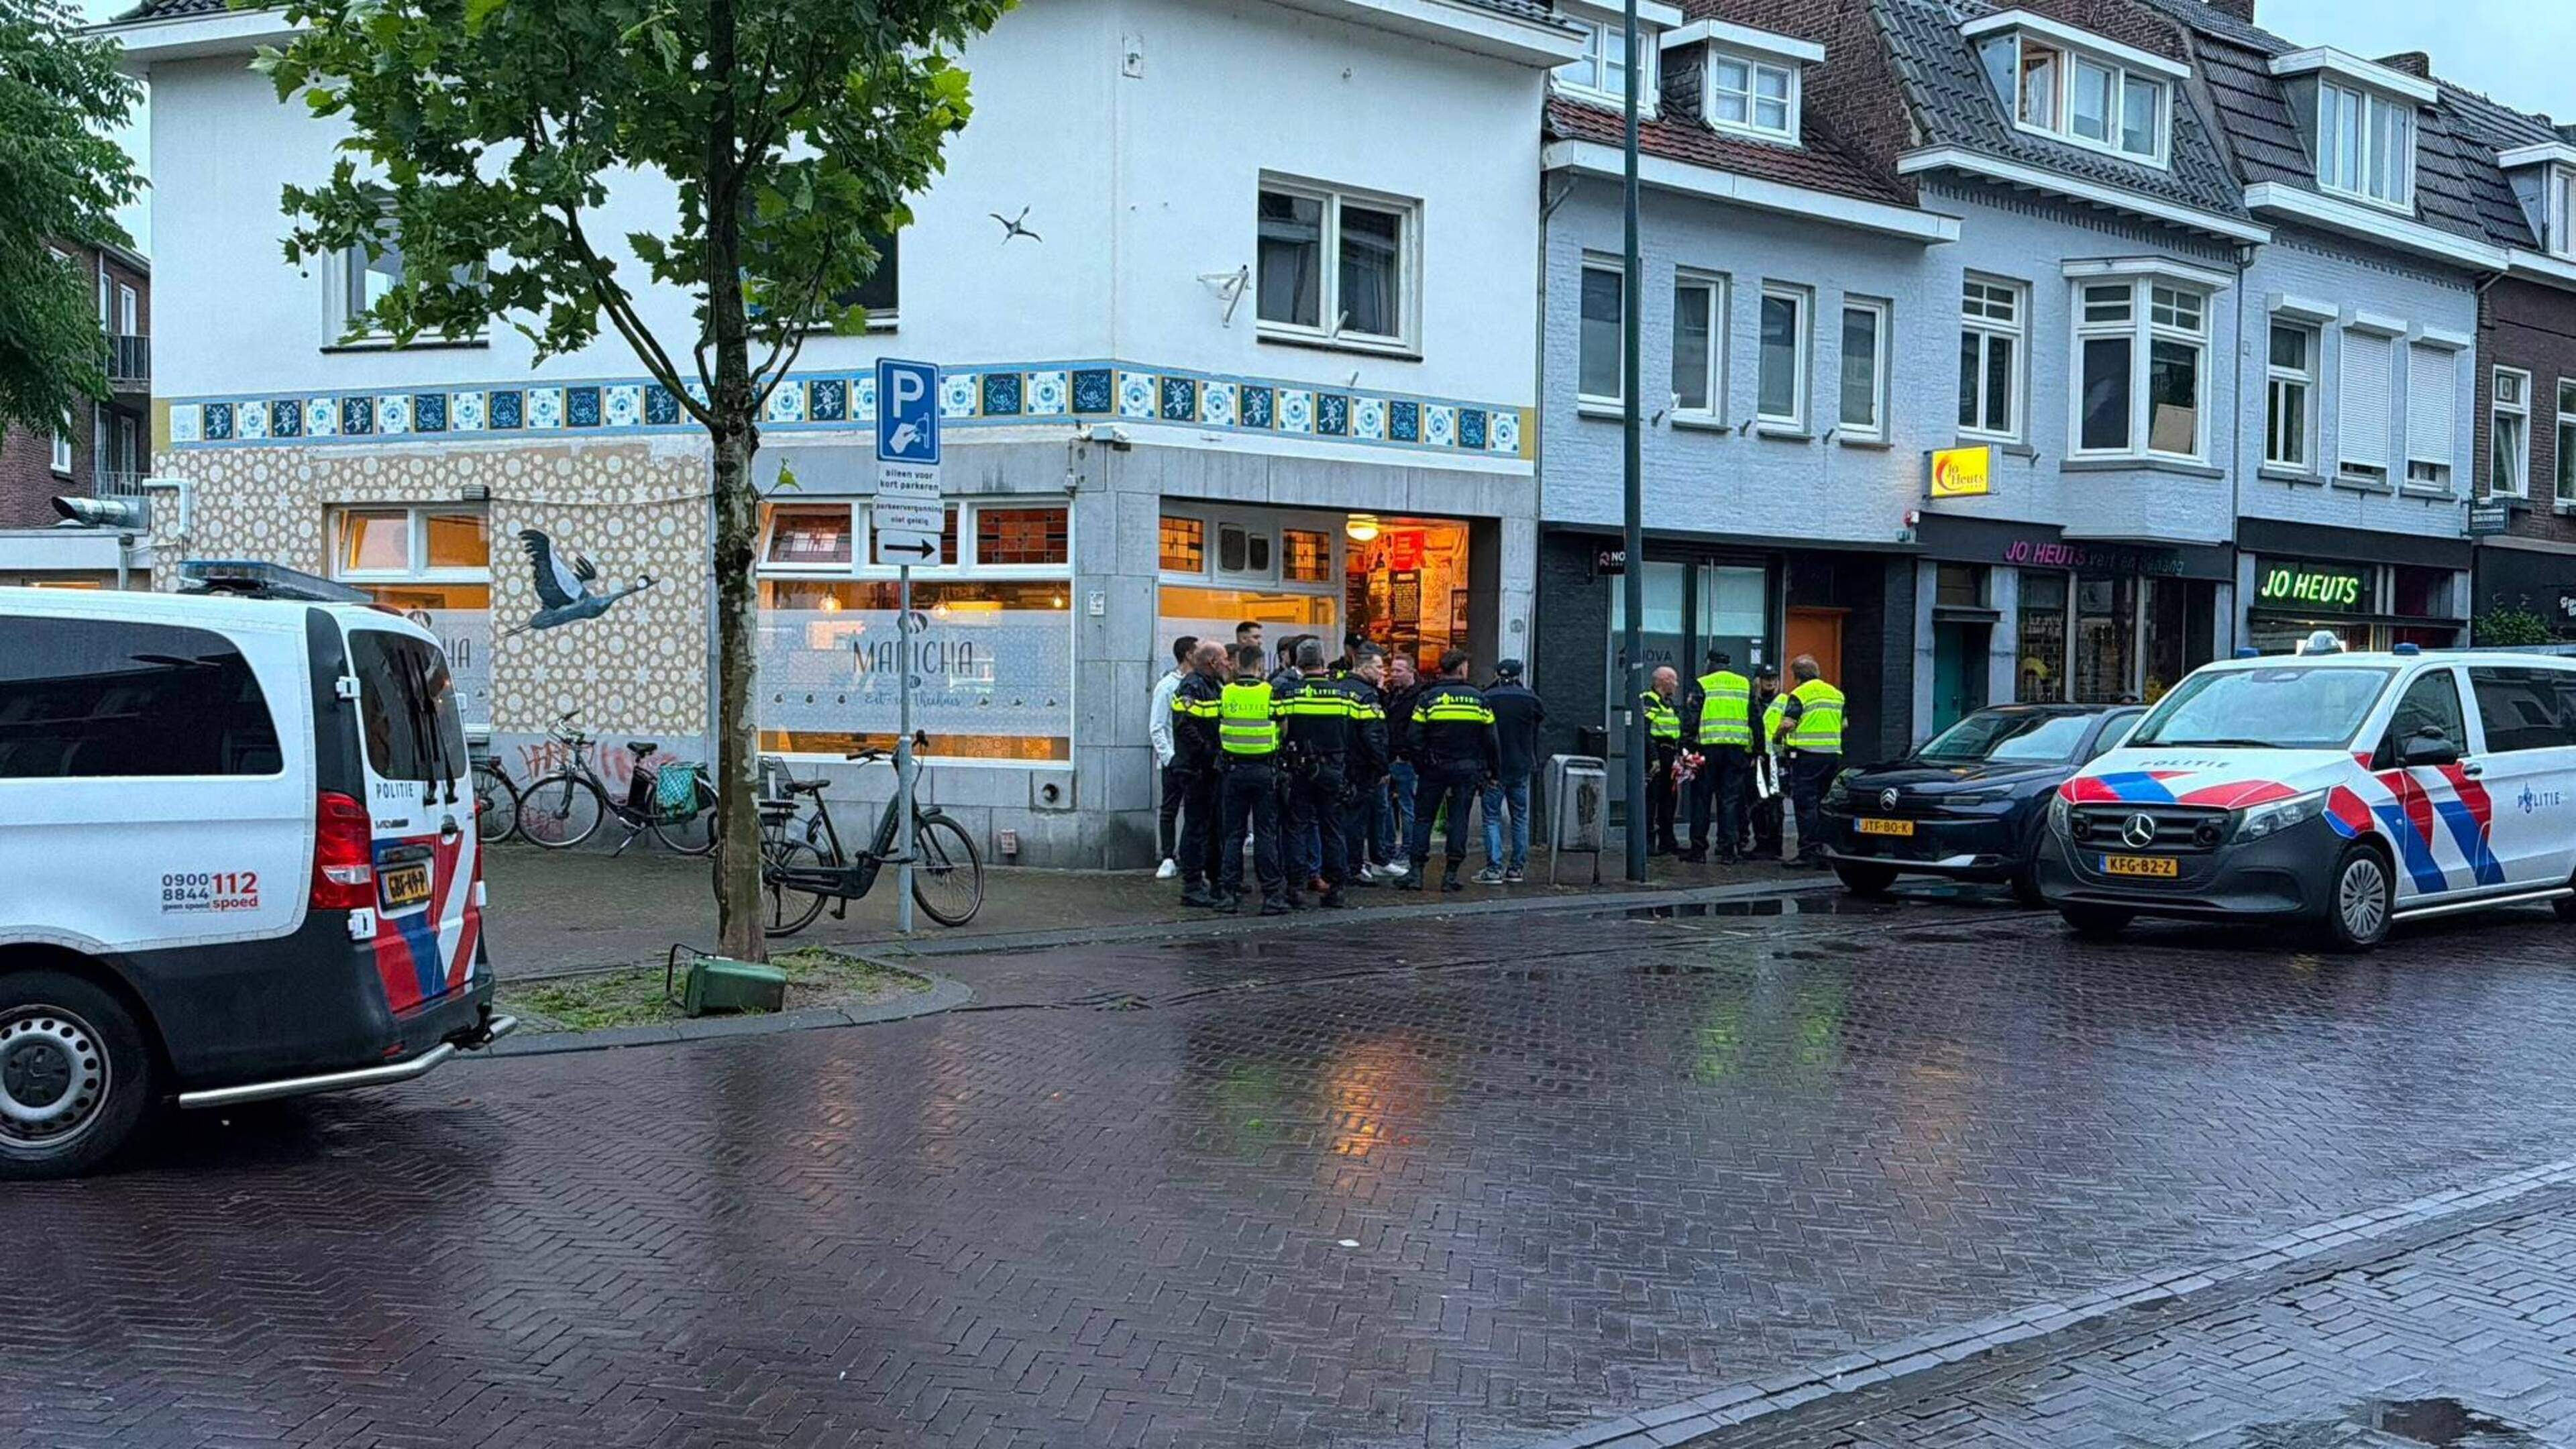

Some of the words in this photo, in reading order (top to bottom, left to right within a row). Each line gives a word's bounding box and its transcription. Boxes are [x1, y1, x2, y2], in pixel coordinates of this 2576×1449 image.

[893, 370, 924, 418] P
[885, 469, 912, 478] alleen
[1951, 474, 1984, 485] Heuts
[880, 480, 898, 488] kort
[900, 482, 938, 491] parkeren
[2006, 541, 2027, 561] JO
[2261, 570, 2290, 597] JO
[2293, 574, 2359, 604] HEUTS
[2138, 760, 2231, 768] POLITIE
[376, 782, 414, 798] POLITIE
[2110, 859, 2171, 873] KFG-82-Z
[162, 873, 209, 886] 0900
[211, 872, 257, 894] 112
[163, 888, 209, 900] 8844
[213, 896, 258, 911] spoed
